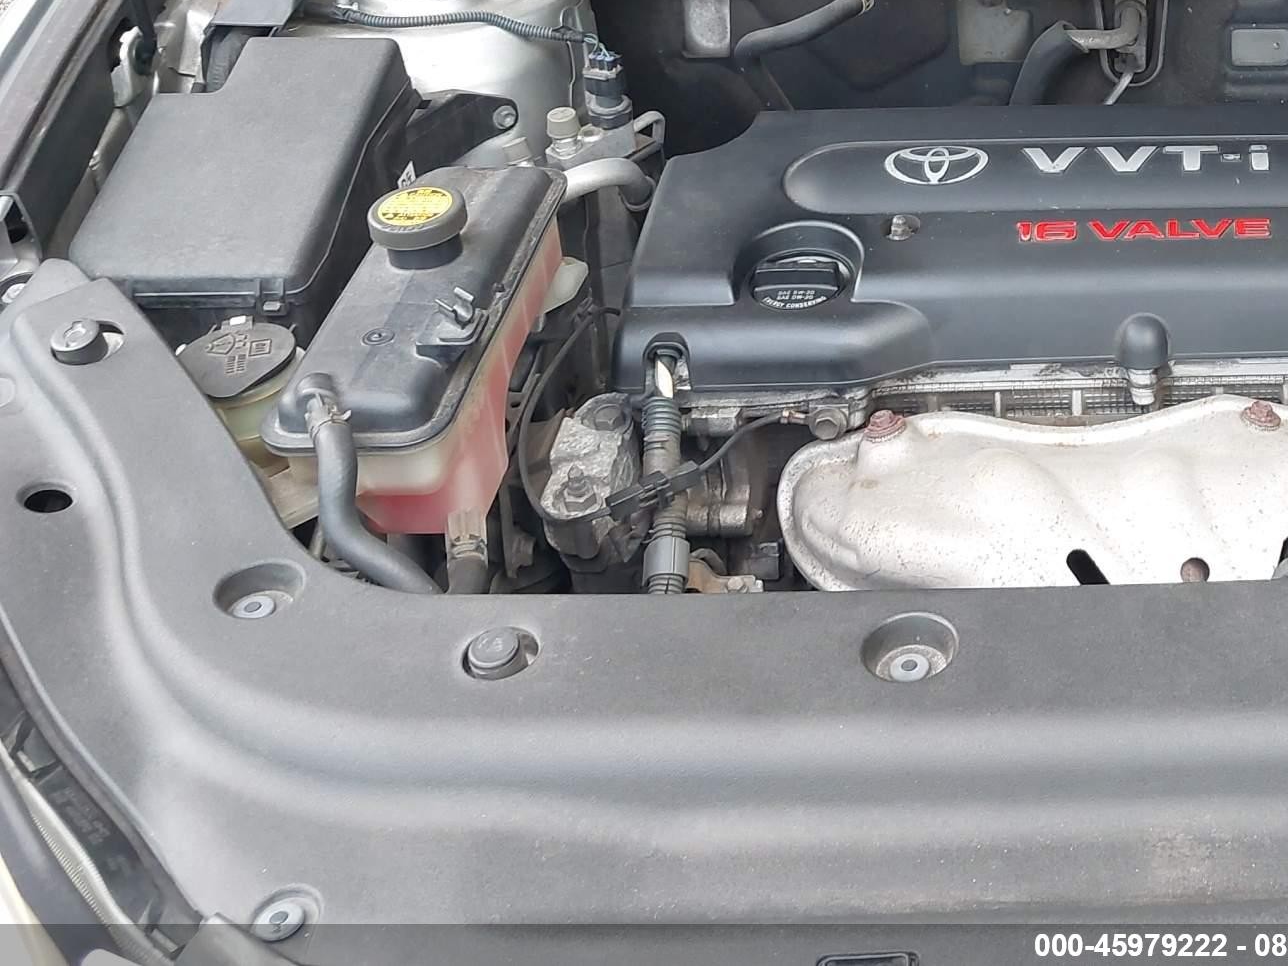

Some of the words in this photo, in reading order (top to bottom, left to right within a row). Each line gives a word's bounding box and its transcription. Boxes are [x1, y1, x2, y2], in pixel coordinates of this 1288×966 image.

[1021, 144, 1271, 174] VVT-i
[1016, 220, 1079, 243] 16
[1087, 218, 1272, 242] VALVE
